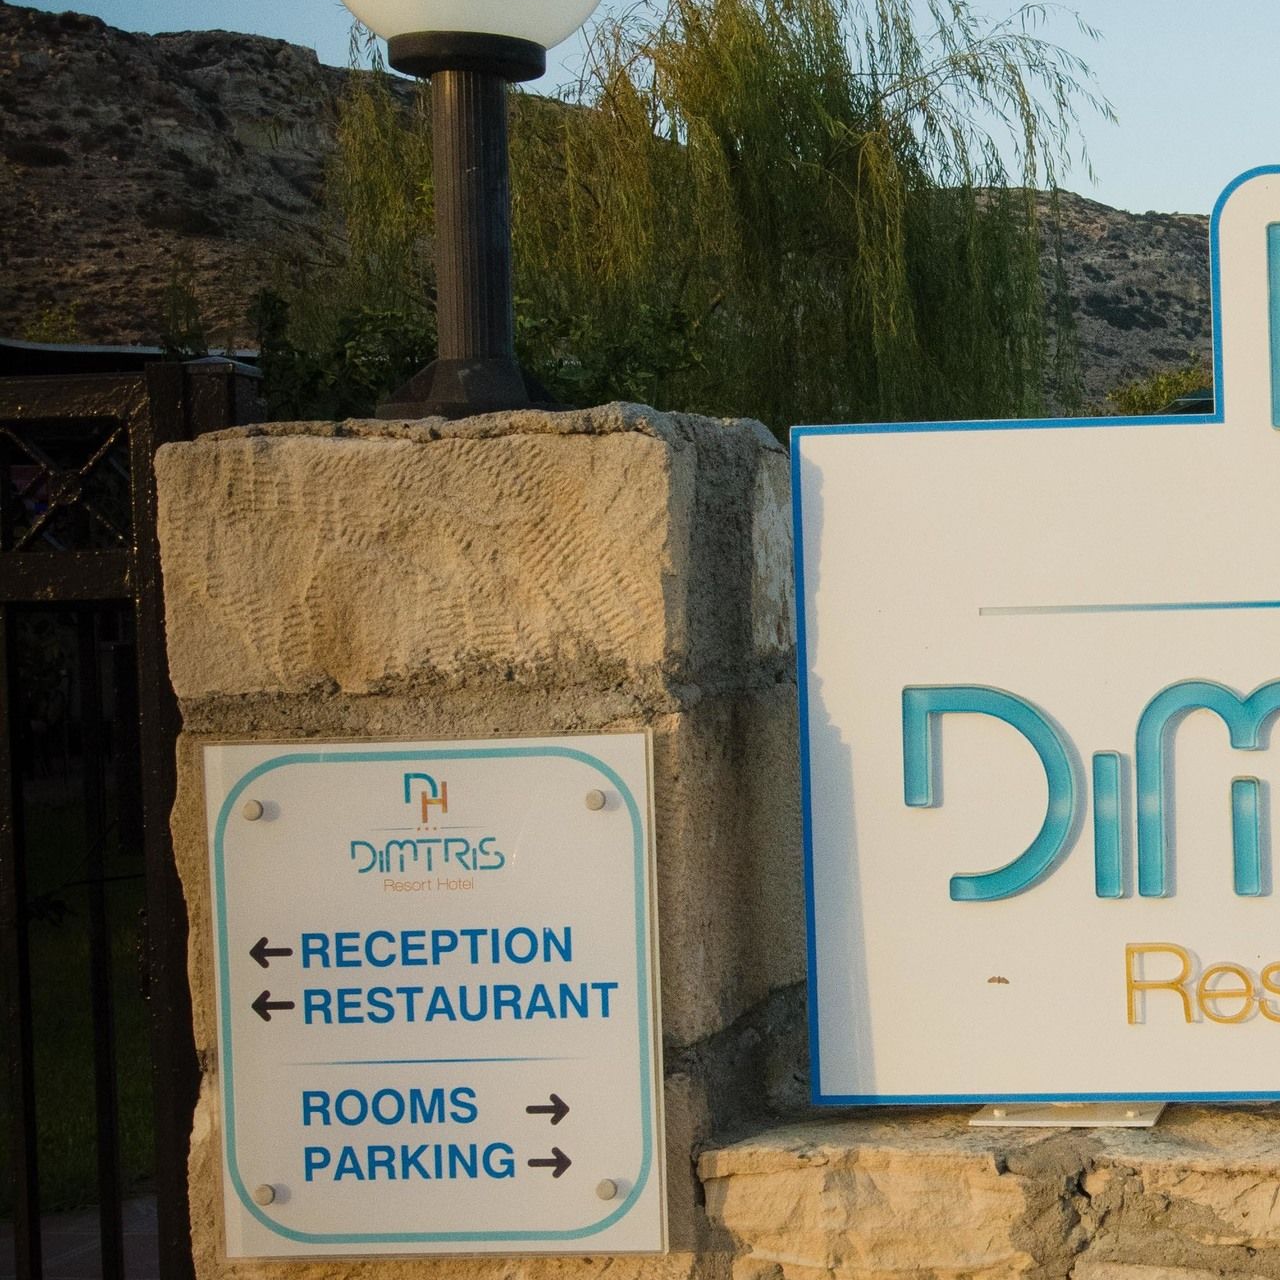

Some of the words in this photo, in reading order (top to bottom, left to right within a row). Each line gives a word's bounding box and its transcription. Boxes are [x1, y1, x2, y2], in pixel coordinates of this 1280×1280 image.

[384, 877, 432, 893] Resort
[437, 876, 475, 891] Hotel
[301, 926, 573, 969] RECEPTION
[303, 982, 619, 1025] RESTAURANT
[302, 1087, 479, 1127] ROOMS
[304, 1143, 516, 1182] PARKING
